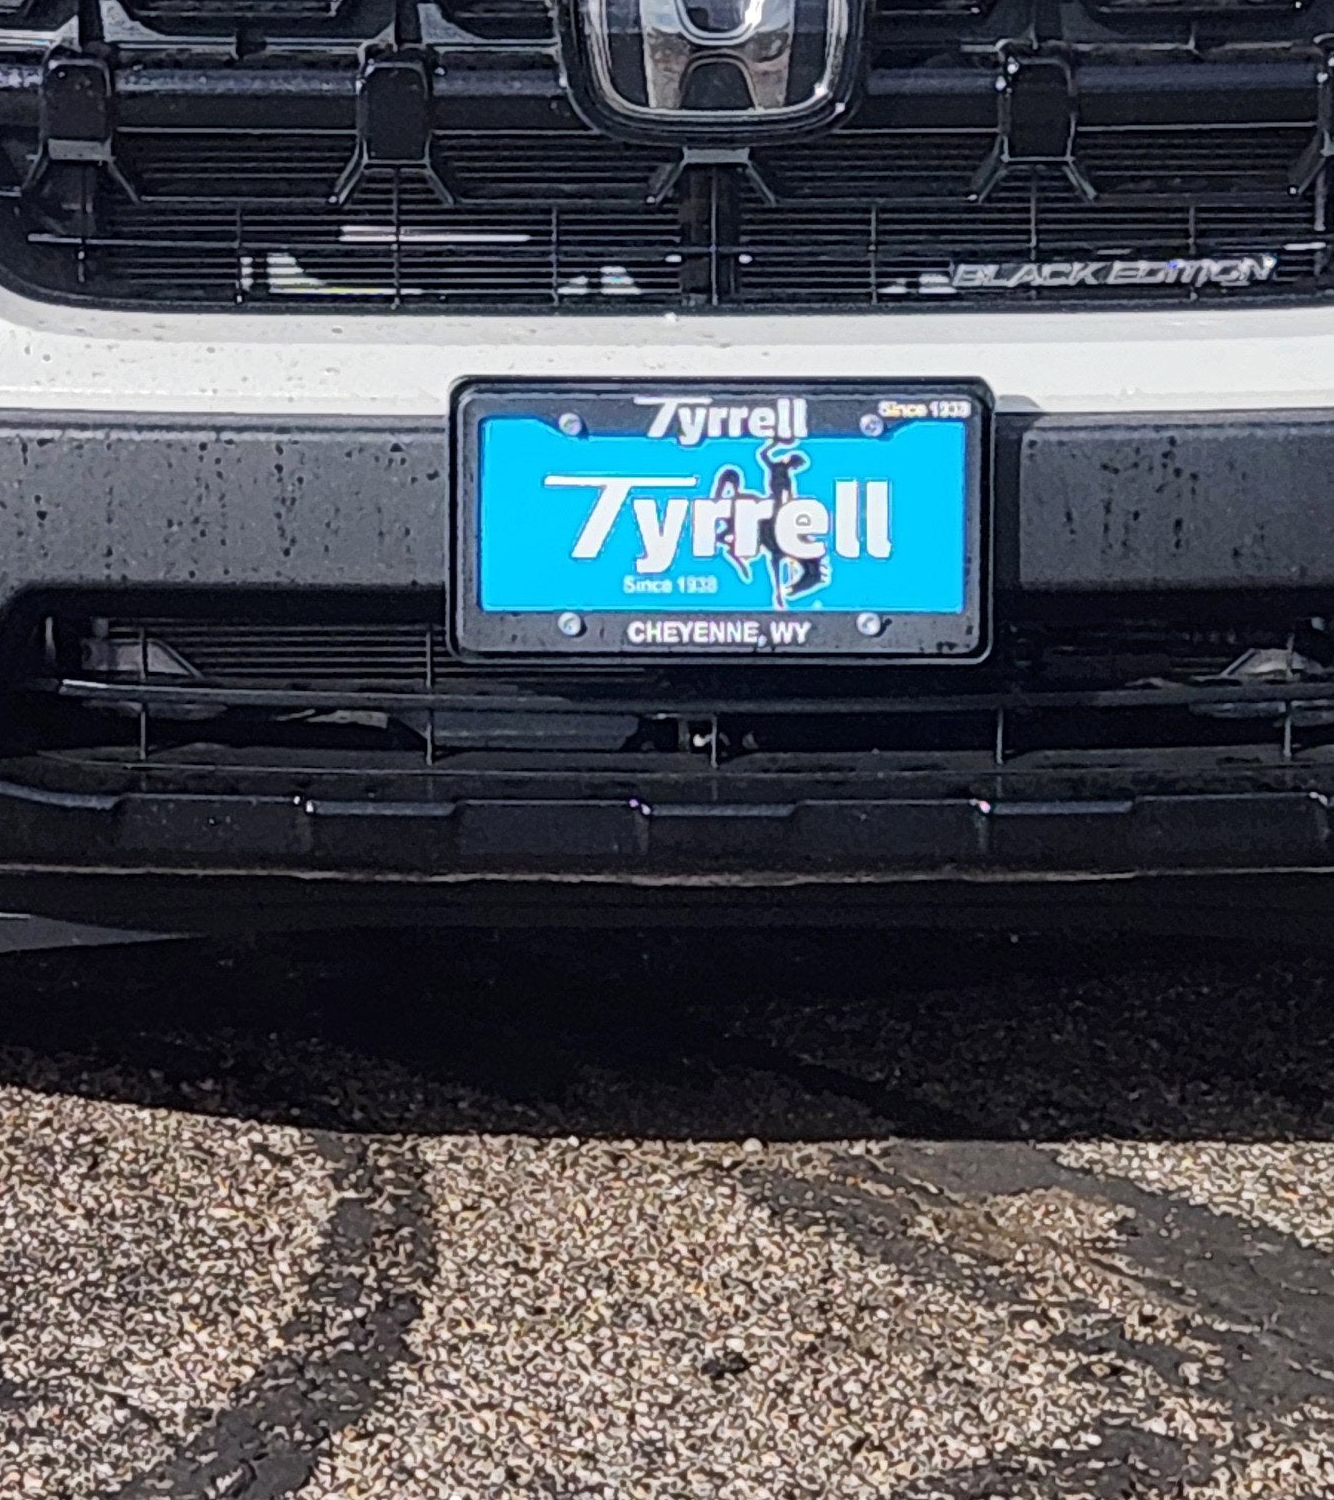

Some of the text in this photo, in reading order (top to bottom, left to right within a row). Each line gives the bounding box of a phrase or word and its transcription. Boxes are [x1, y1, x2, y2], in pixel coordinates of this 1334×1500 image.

[952, 255, 1277, 288] BLACK EDITION
[633, 396, 808, 446] Tyrrell
[878, 401, 927, 418] Since
[543, 474, 893, 573] Tyrrell
[623, 574, 673, 594] Since
[627, 620, 812, 647] CHEYENNE, WY
